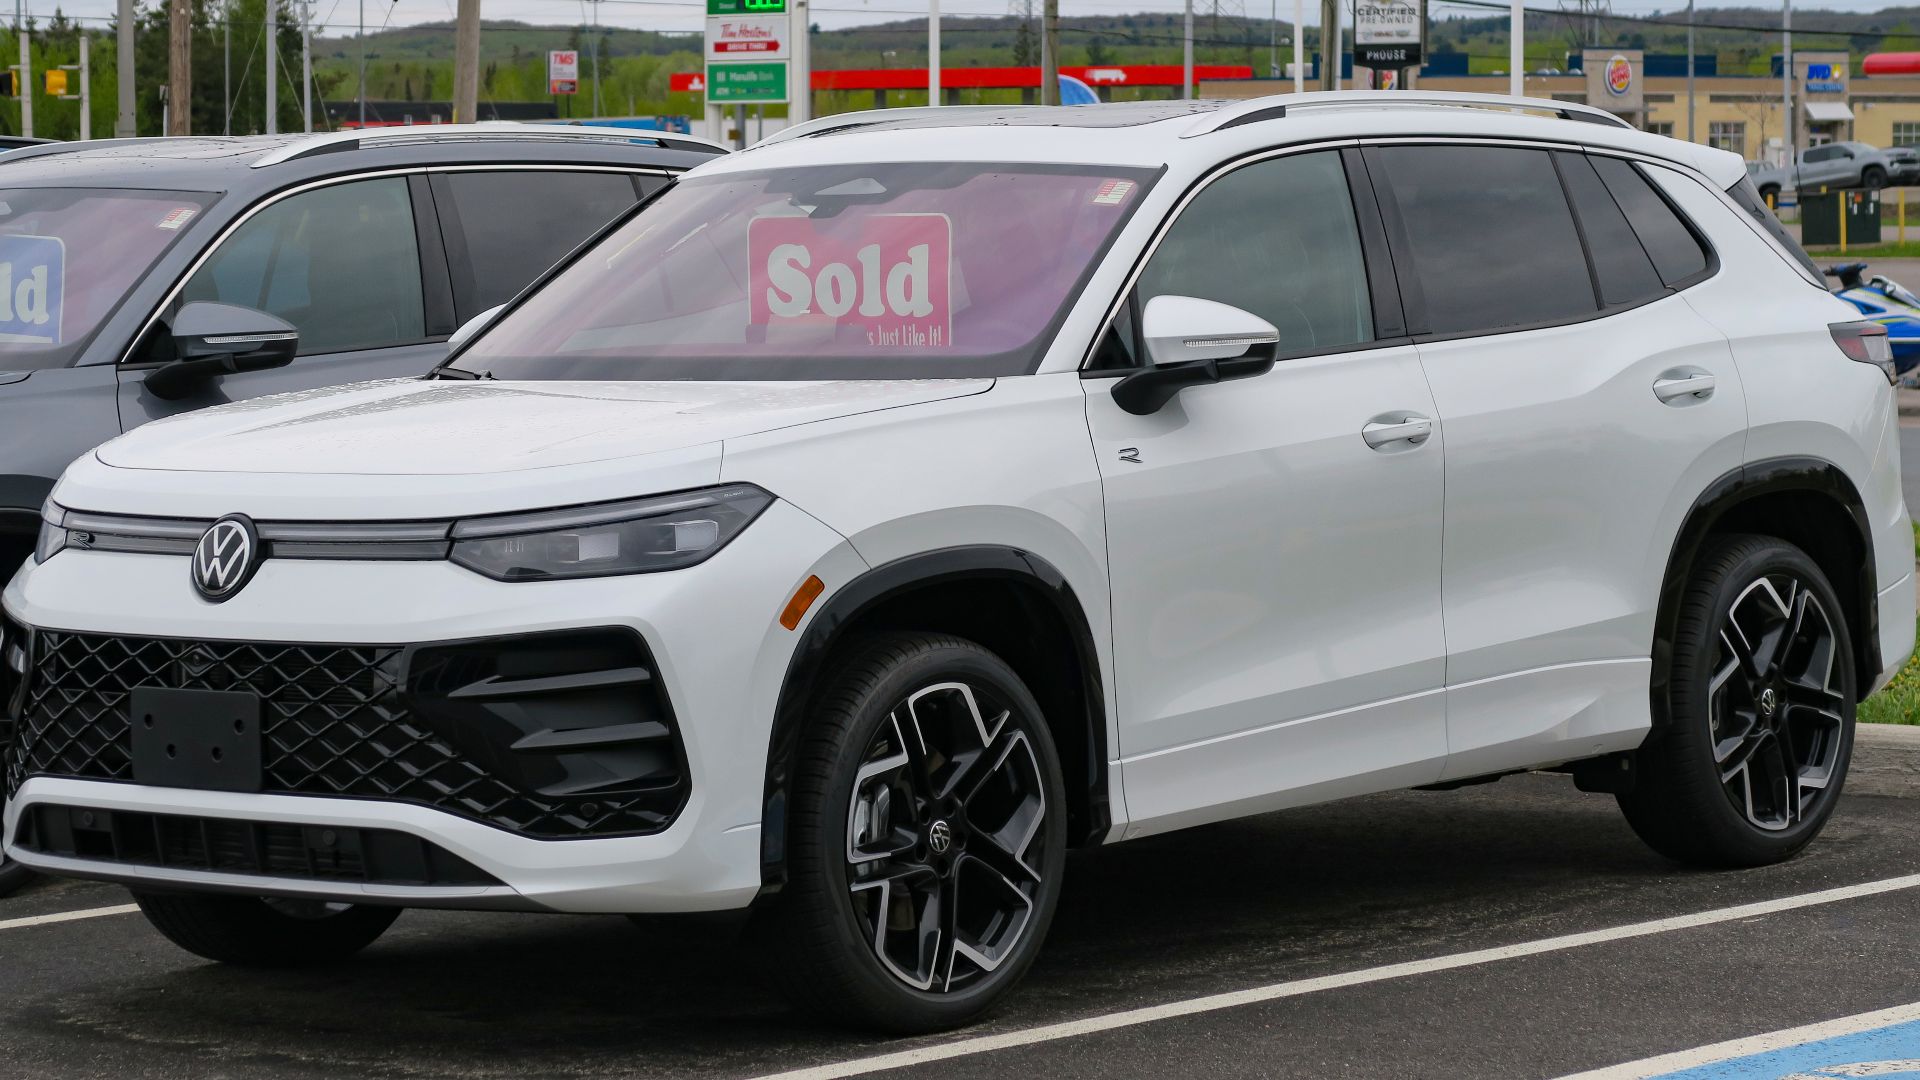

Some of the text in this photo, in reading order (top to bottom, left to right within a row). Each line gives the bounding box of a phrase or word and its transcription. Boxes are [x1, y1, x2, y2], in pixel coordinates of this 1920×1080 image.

[721, 24, 773, 38] Tim Hortons
[553, 53, 575, 65] TMS
[729, 71, 757, 81] Manulife
[767, 243, 933, 317] Sold
[0, 262, 50, 324] ld
[877, 324, 899, 346] Just
[902, 323, 926, 346] Like
[929, 324, 942, 346] It!
[197, 524, 248, 590] VW
